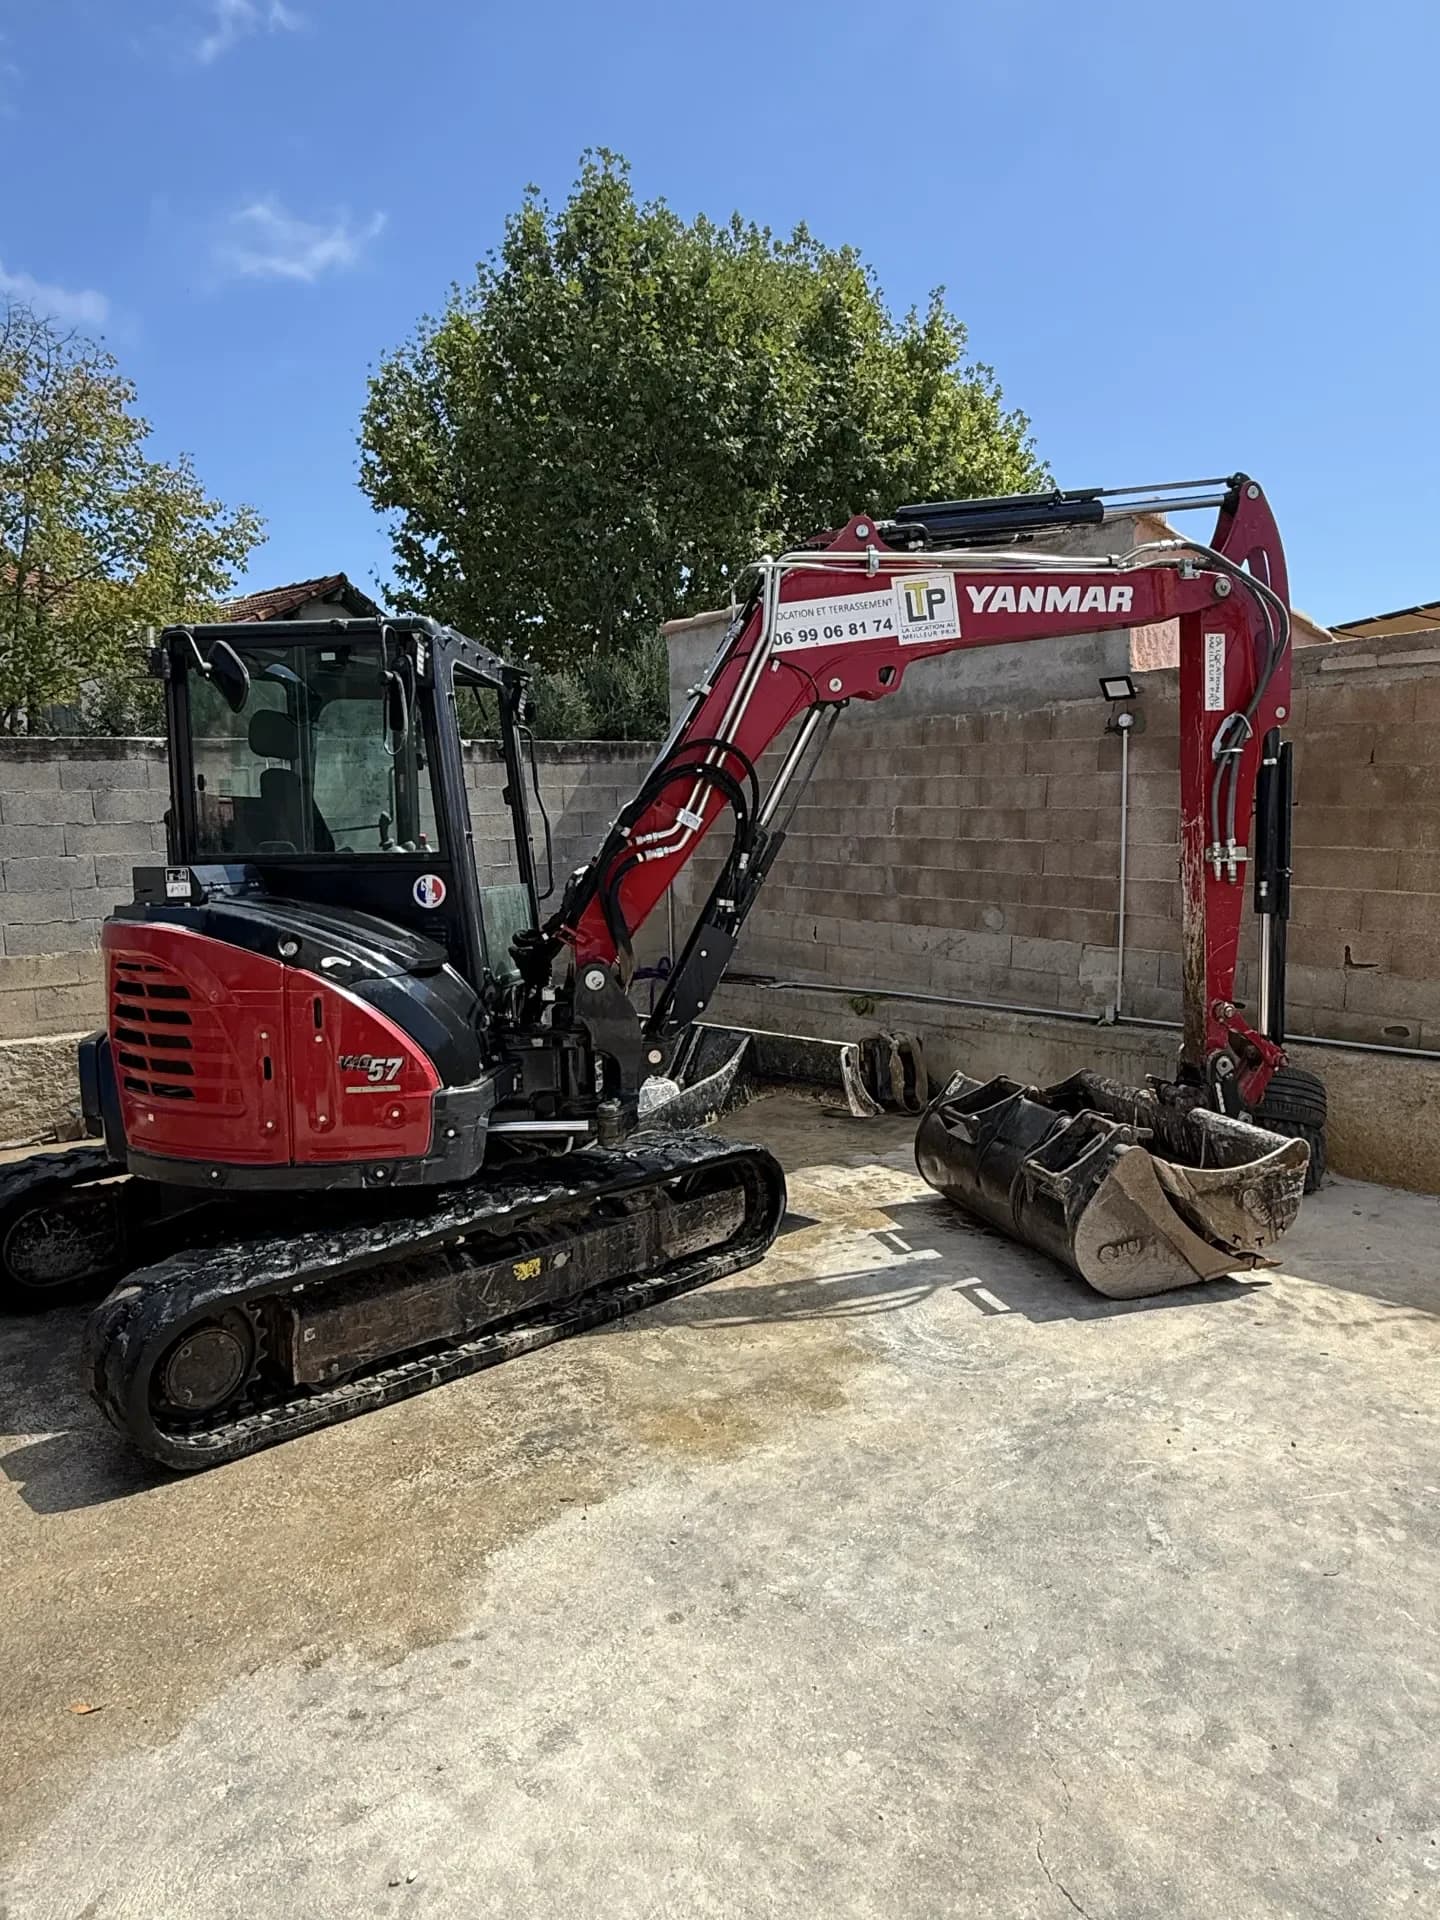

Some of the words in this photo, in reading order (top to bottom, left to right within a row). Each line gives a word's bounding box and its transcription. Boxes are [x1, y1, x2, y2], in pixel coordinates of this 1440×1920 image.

[776, 607, 814, 621] OCATION
[816, 605, 827, 616] ET
[828, 598, 893, 616] TERRASSEMENT
[965, 586, 1133, 613] YANMAR
[774, 631, 793, 646] 06
[798, 628, 818, 643] 99
[823, 625, 843, 639] 06
[849, 621, 867, 636] 81
[873, 617, 893, 631] 74
[902, 631, 938, 640] MEILLEUR
[912, 623, 945, 633] LOCATION
